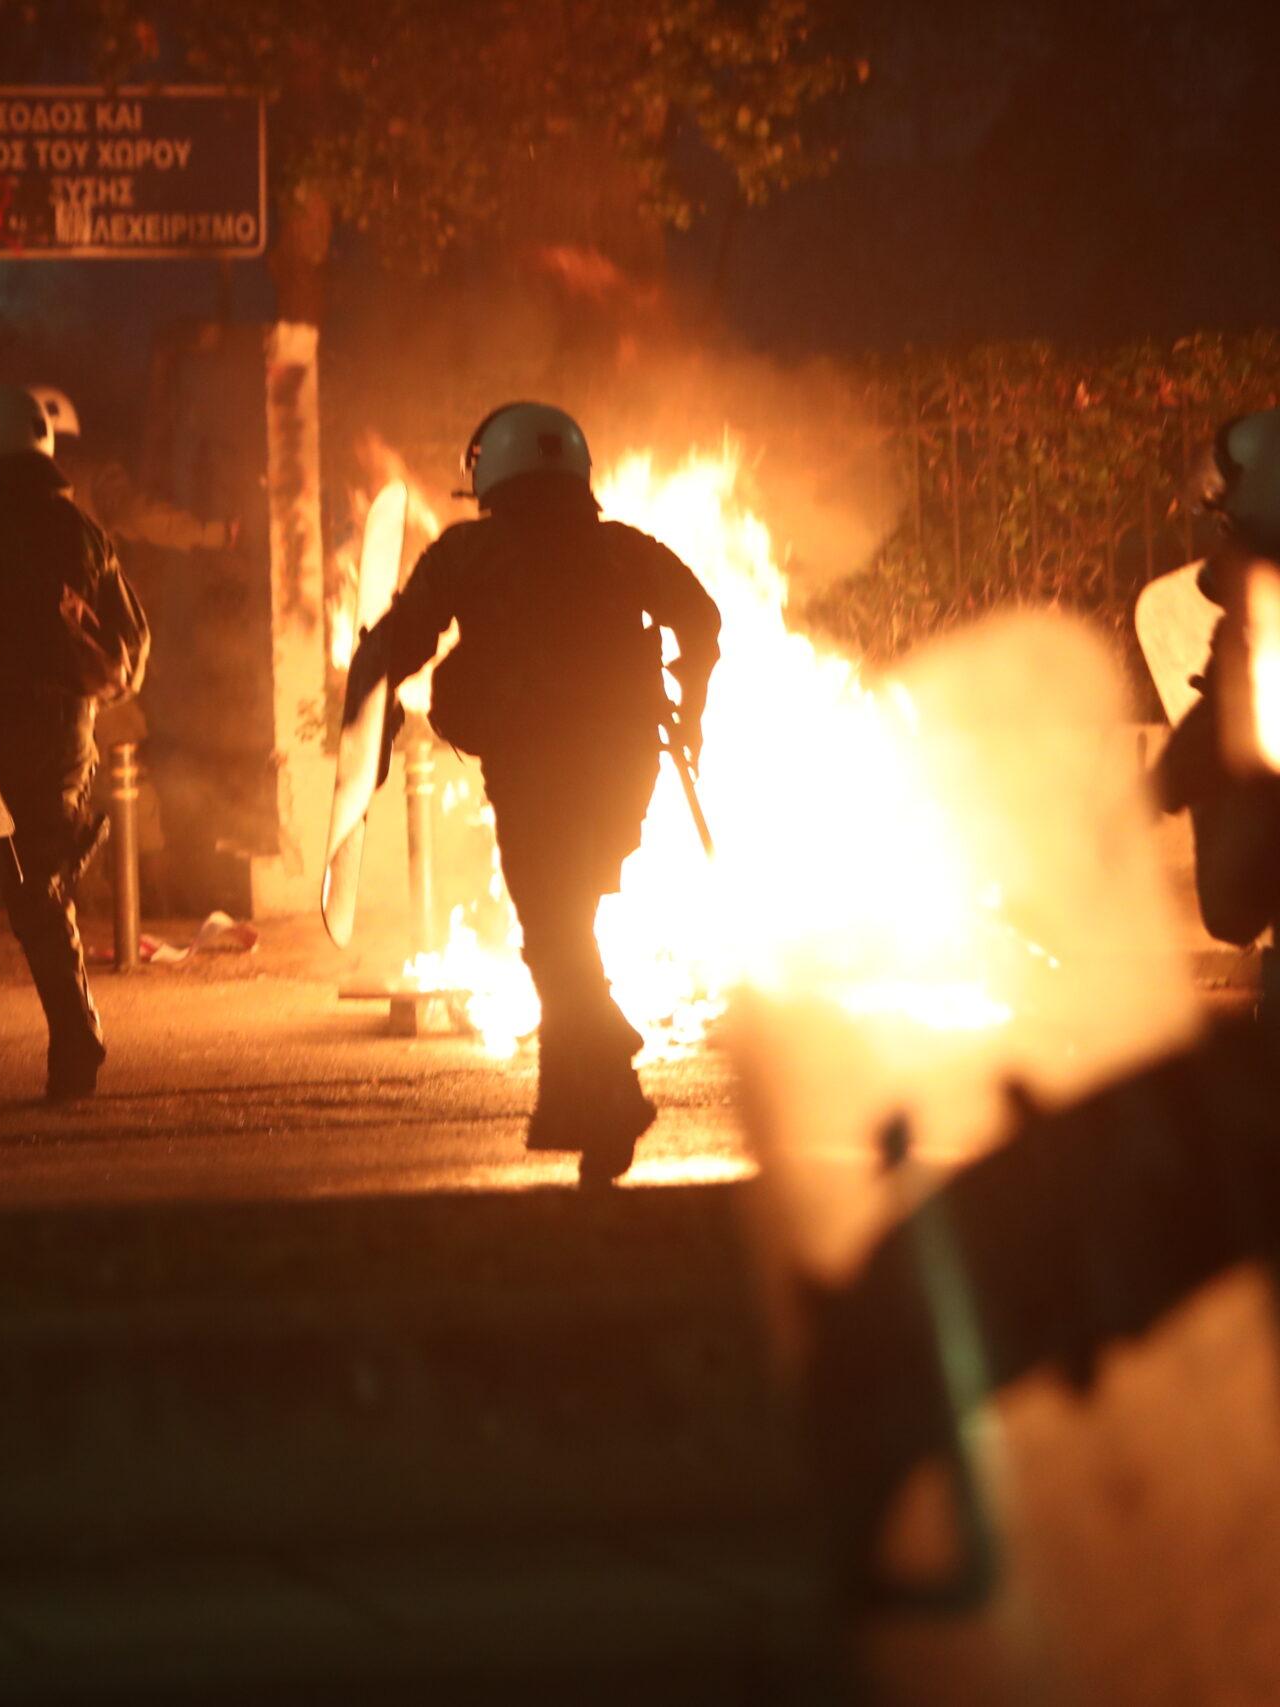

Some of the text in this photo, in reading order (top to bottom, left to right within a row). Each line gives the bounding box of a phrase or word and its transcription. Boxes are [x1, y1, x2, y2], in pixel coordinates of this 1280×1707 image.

[96, 103, 143, 131] ΚΑΙ
[33, 138, 90, 170] ΤΟΥ
[97, 138, 192, 170] ΧΩΡΟΥ
[57, 214, 257, 242] ΛΕΧΕΙΡΙΣΜΟ
